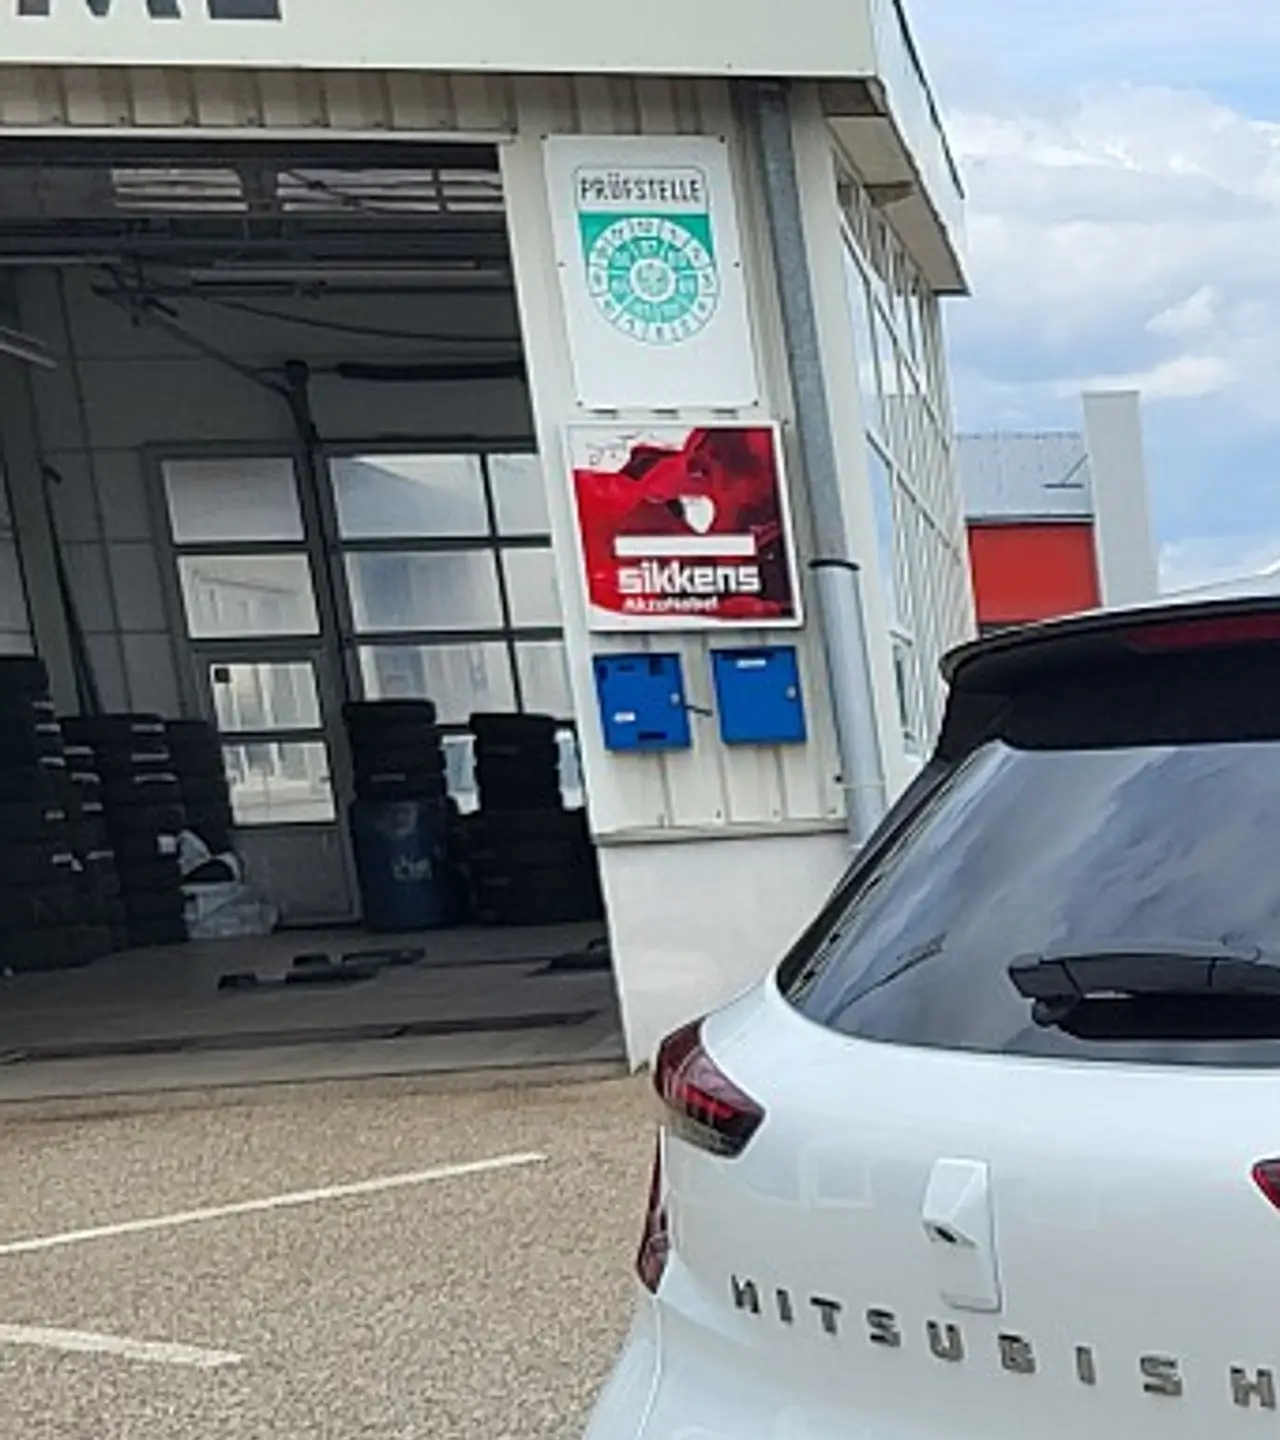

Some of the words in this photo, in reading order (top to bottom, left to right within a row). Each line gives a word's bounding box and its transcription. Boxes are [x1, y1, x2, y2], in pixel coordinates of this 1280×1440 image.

[580, 173, 701, 203] PRÜFSTELLE
[618, 561, 760, 593] sikkens
[622, 596, 719, 612] AkzoNobel
